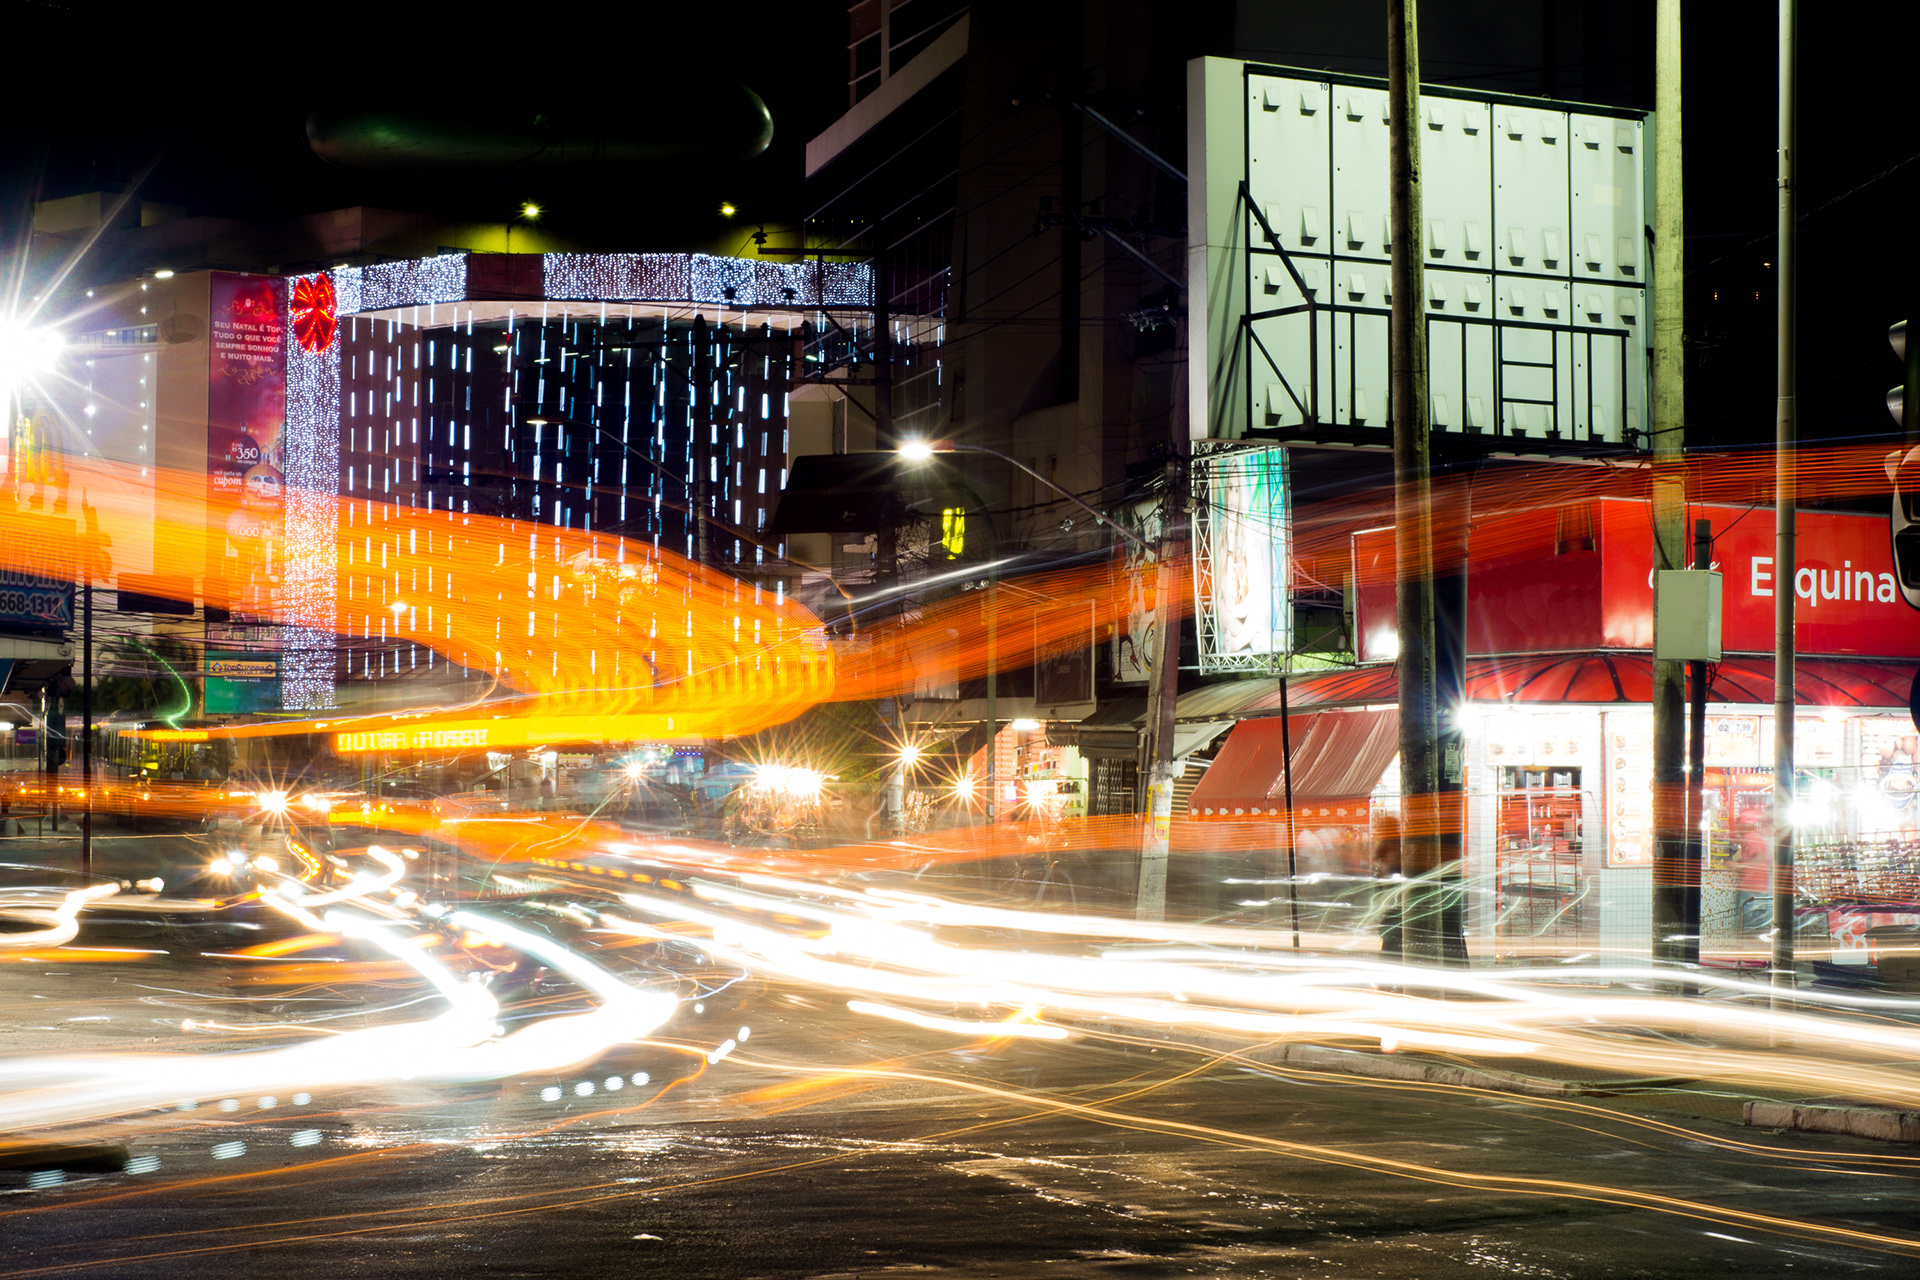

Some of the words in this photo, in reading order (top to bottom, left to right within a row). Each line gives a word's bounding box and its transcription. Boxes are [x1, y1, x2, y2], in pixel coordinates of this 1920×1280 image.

[1320, 83, 1328, 91] 10
[1637, 121, 1642, 129] 6
[1486, 276, 1490, 284] 3
[1564, 283, 1568, 291] 4
[1640, 290, 1645, 298] 5
[214, 320, 230, 329] SEU
[232, 322, 257, 331] NATAL
[259, 324, 264, 332] É
[266, 325, 283, 333] TOP.
[213, 331, 234, 339] TUDO
[244, 334, 260, 342] QUE
[262, 335, 281, 343] VOCÊ
[215, 342, 246, 351] SEMPRE
[247, 344, 279, 353] SONHOU
[227, 353, 252, 361] MUITO
[236, 447, 258, 459] 350
[213, 475, 242, 488] cupom
[1751, 556, 1896, 607] Equina
[1718, 724, 1728, 732] 02
[1736, 723, 1750, 732] 7,99
